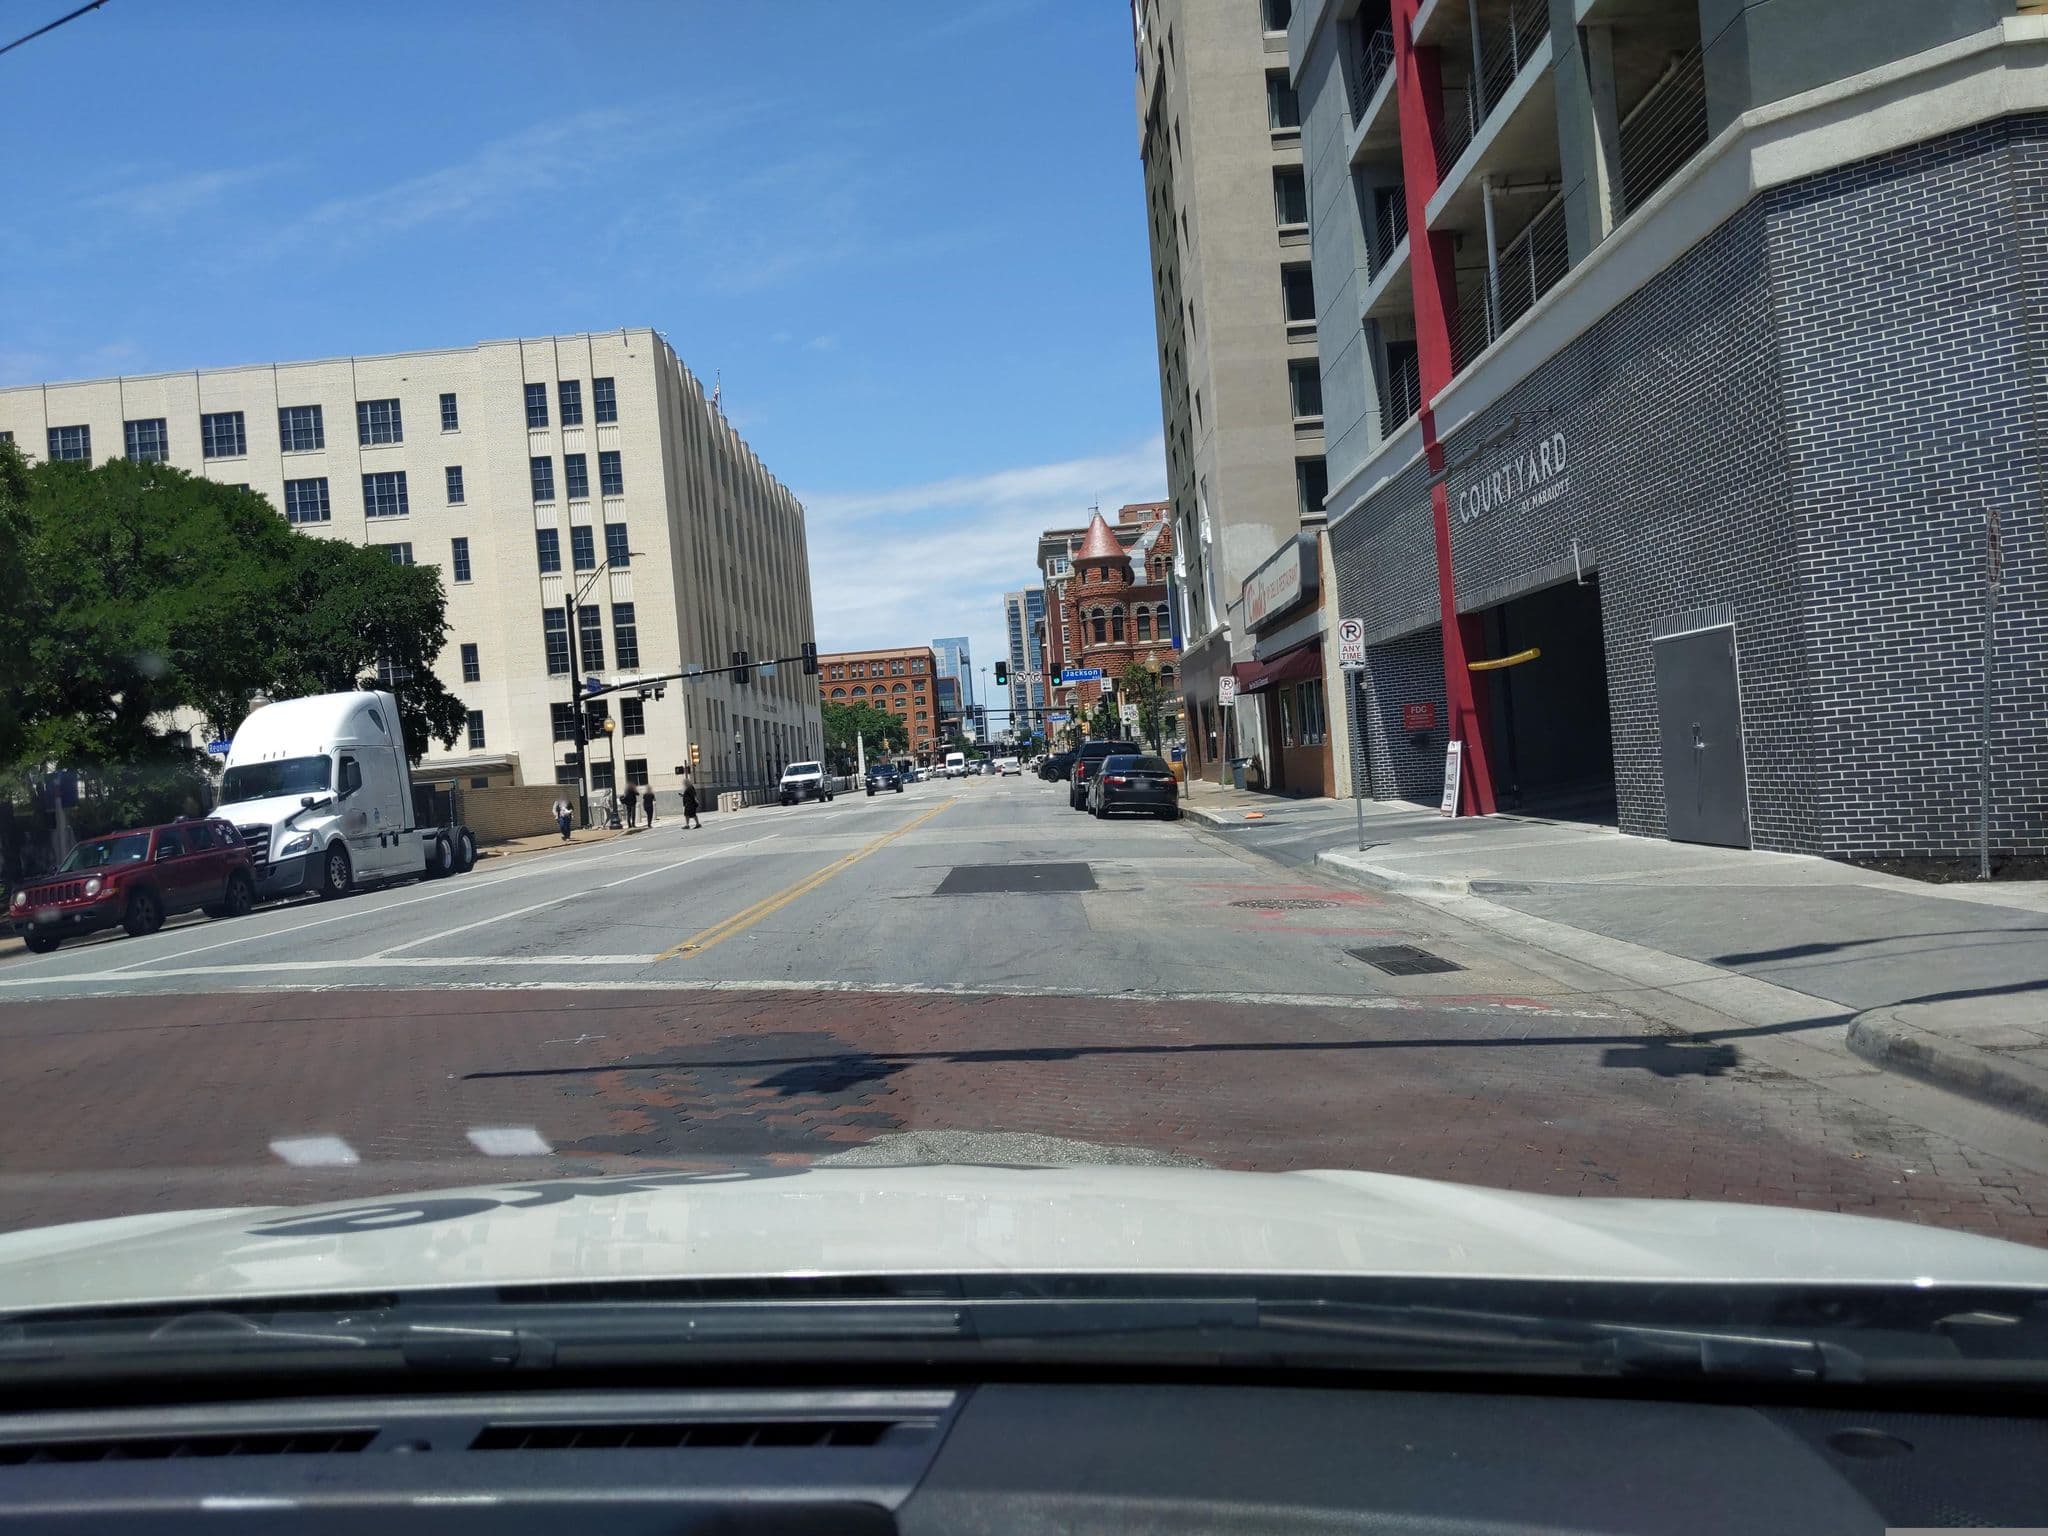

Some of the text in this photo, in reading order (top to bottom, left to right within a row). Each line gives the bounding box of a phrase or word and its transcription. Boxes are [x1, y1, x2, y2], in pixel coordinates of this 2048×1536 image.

[1459, 432, 1567, 523] COURTYARD
[1532, 478, 1569, 509] MARRIOTT
[1342, 645, 1361, 653] ANY
[1342, 652, 1362, 660] TIME
[1065, 669, 1098, 677] Jackson
[1410, 705, 1427, 714] FDC
